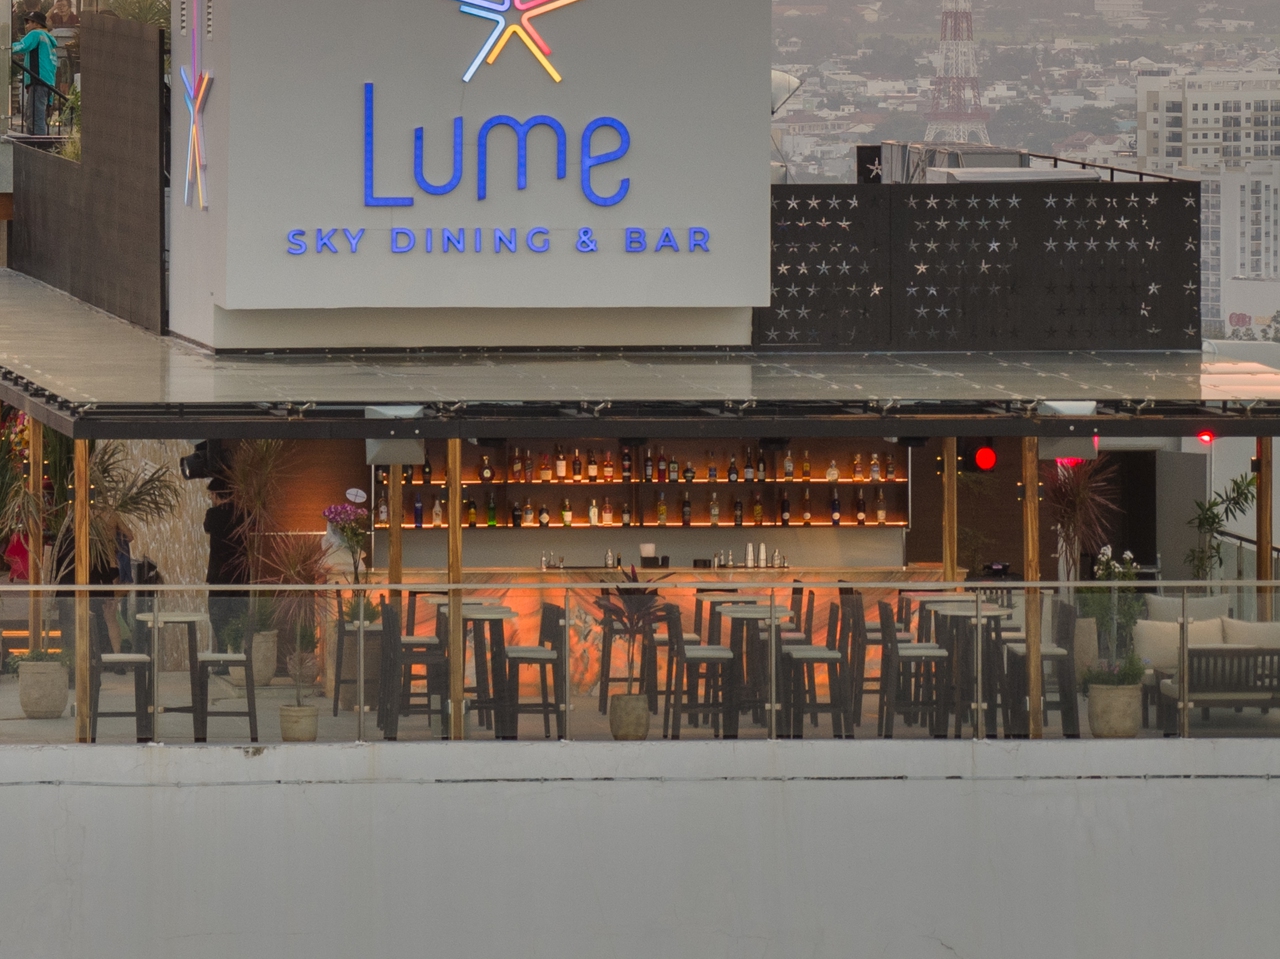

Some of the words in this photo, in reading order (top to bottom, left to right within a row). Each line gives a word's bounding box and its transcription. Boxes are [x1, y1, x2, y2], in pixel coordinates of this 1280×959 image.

[363, 82, 631, 207] Lume
[287, 227, 365, 255] SKY
[390, 227, 551, 254] DINING
[575, 227, 599, 253] &
[624, 226, 711, 253] BAR
